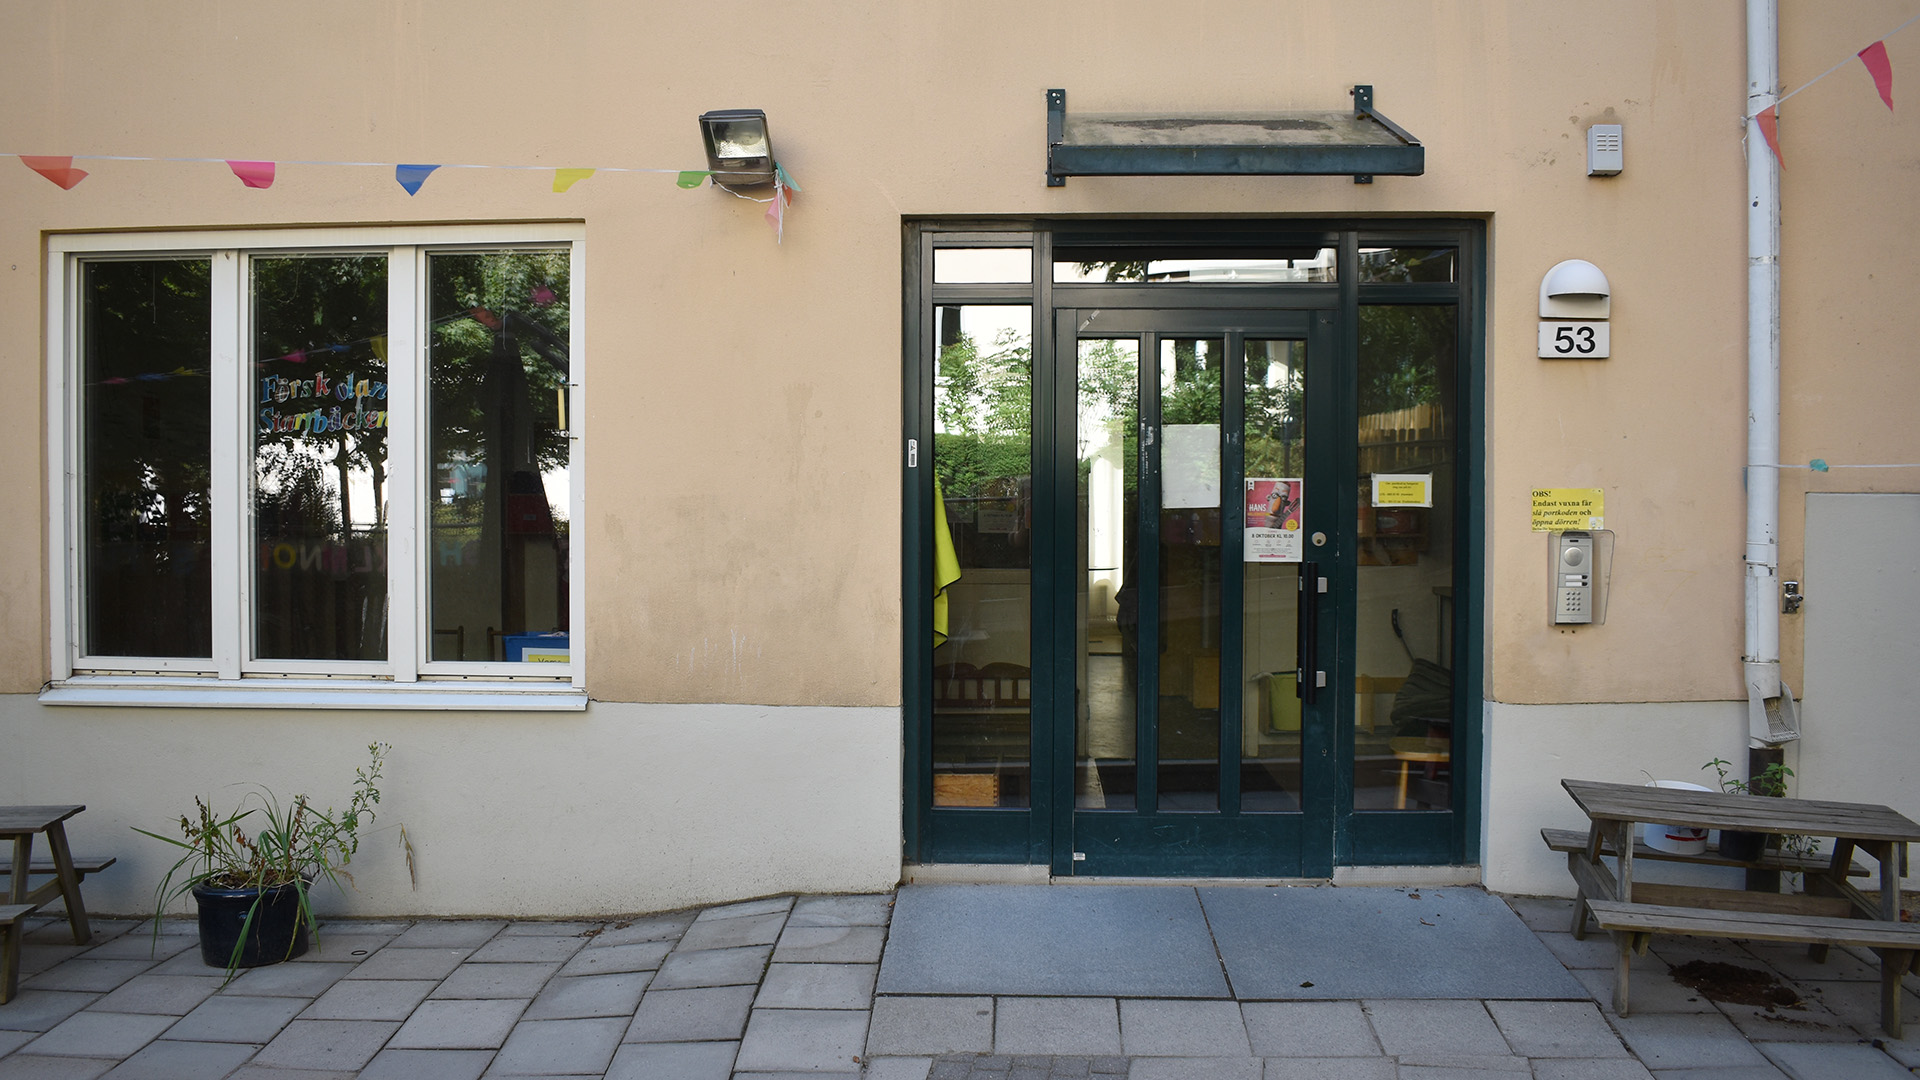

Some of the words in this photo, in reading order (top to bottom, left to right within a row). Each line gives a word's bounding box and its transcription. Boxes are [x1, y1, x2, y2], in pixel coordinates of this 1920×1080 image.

[1554, 326, 1596, 354] 53
[1532, 490, 1551, 498] OBS!
[1249, 503, 1267, 512] HANS
[1543, 509, 1578, 518] portkoden
[1532, 519, 1554, 527] öppna
